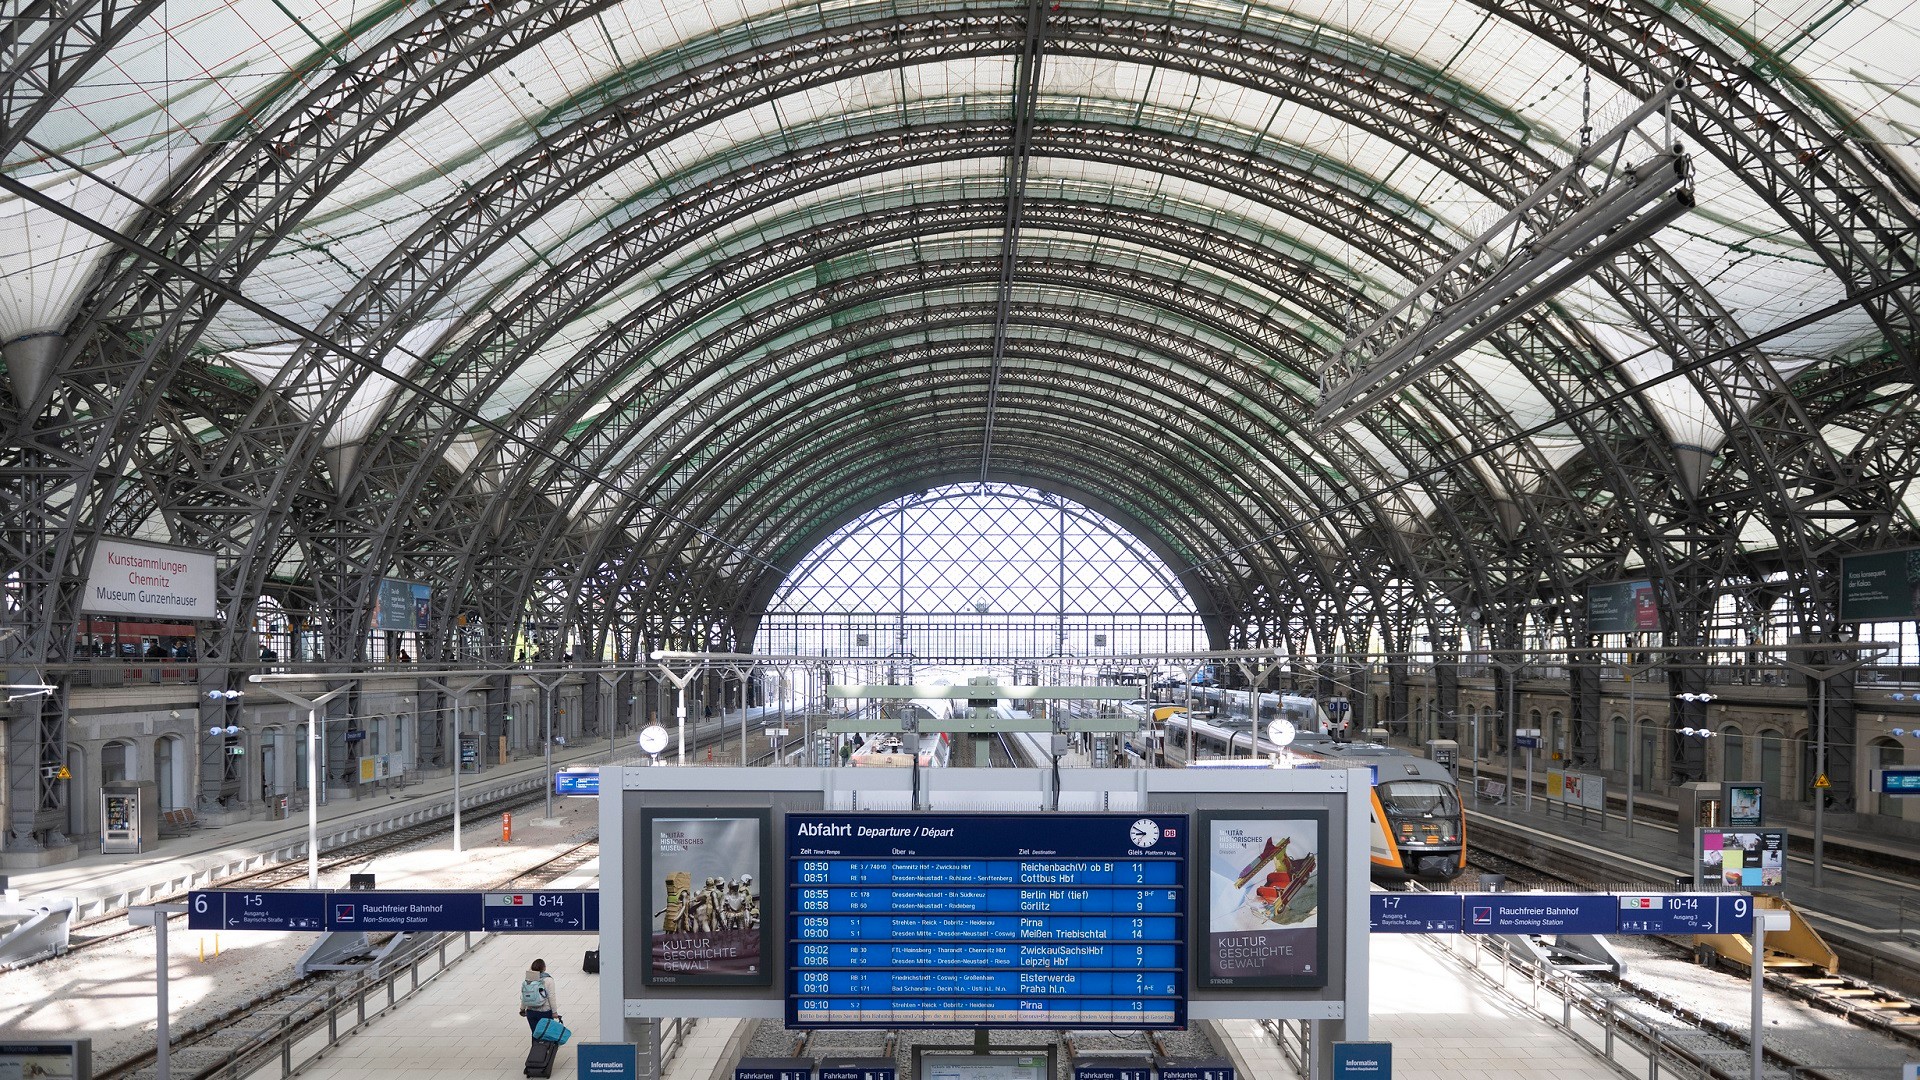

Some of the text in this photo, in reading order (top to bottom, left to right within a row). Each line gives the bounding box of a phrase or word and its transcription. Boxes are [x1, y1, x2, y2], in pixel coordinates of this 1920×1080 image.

[108, 552, 187, 574] Kunstsammlungen
[129, 572, 169, 587] Chemnitz
[96, 587, 197, 606] Museum Gunzenhauser
[798, 823, 954, 838] Abfahrt Departure Départ
[1164, 829, 1176, 838] DB
[1021, 863, 1087, 872] Reichenbach(V)
[1090, 863, 1101, 871] ob
[1105, 863, 1114, 871] Bf
[804, 874, 829, 882] 08:51
[1021, 874, 1056, 882] Cottbus
[1059, 874, 1074, 882] Hbf
[1137, 875, 1143, 883] 2
[243, 895, 262, 906] 1-5
[539, 895, 563, 906] 8-14
[804, 890, 829, 898] 08:55
[1020, 891, 1046, 899] Berlin
[1050, 891, 1064, 899] Hbf
[1068, 891, 1088, 900] (tief)
[195, 894, 208, 913] 6
[1021, 902, 1050, 910] Görlitz
[1137, 902, 1142, 910] 9
[1382, 898, 1400, 908] 1-7
[1668, 898, 1698, 910] 10-14
[1734, 899, 1747, 918] 9
[804, 918, 829, 926] 08:59
[1020, 918, 1043, 927] Pirna
[1132, 919, 1143, 927] 13
[1020, 930, 1052, 938] Meißen
[1056, 930, 1106, 938] Triebischtal
[1132, 930, 1142, 939] 14
[662, 939, 710, 951] KULTUR
[1219, 936, 1267, 948] KULTUR
[664, 948, 737, 960] GESCHICHTE
[804, 946, 829, 954] 09:02
[1137, 947, 1142, 955] 8
[1220, 946, 1293, 958] GESCHICHTE
[664, 960, 710, 971] GEWALT
[804, 957, 829, 965] 09:06
[1020, 957, 1050, 968] Leipzig
[1054, 957, 1068, 966] Hbf
[1137, 958, 1142, 966] 7
[1220, 958, 1266, 969] GEWALT
[804, 974, 829, 982] 09:08
[1020, 974, 1075, 982] Elsterwerda
[1137, 974, 1142, 983] 2
[804, 984, 829, 992] 09:10
[1020, 985, 1046, 993] Praha
[1050, 985, 1066, 993] hl.n.
[1020, 1001, 1043, 1009] Pirna
[1132, 1002, 1142, 1010] 13
